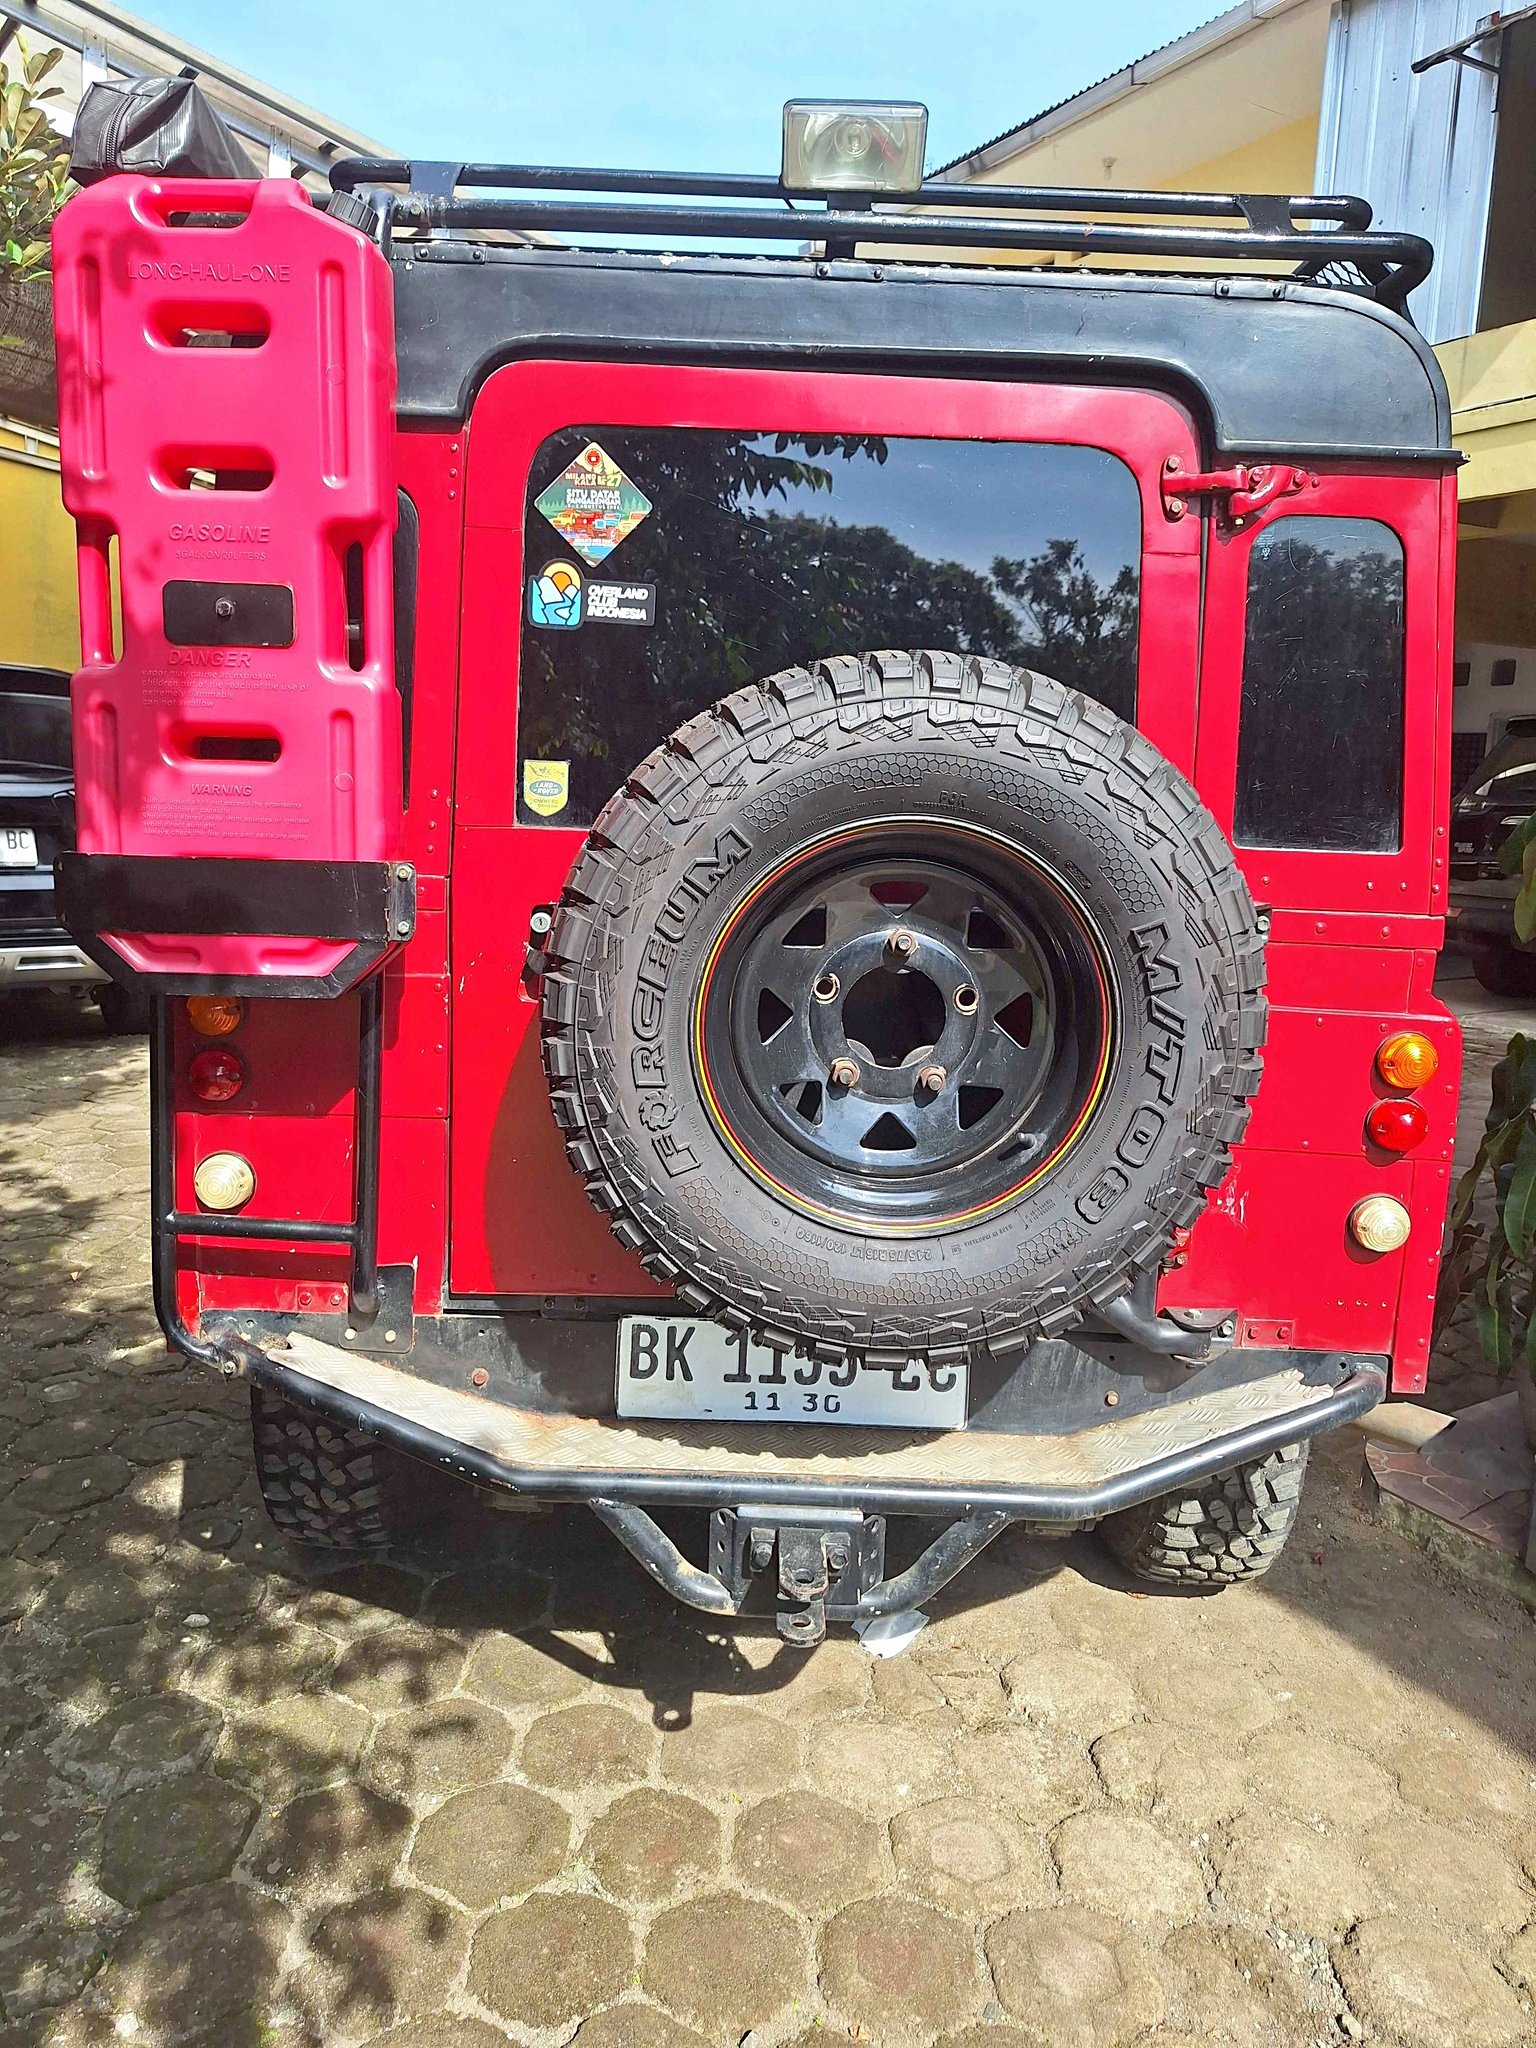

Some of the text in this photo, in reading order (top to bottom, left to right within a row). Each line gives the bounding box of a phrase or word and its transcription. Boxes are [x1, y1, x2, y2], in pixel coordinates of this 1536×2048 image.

[127, 261, 292, 283] LONG-HAUL-ONE
[566, 488, 620, 499] SITU DATAR
[169, 524, 271, 543] GASOLINE
[587, 585, 649, 600] OVERLAND
[587, 595, 619, 608] CLUB
[586, 605, 647, 620] INDONESIA
[167, 650, 252, 668] DANGER
[141, 669, 167, 678] vapor
[190, 671, 217, 679] cause
[233, 672, 277, 682] explosion
[141, 678, 178, 688] children
[225, 680, 251, 690] reach
[281, 684, 298, 692] use
[178, 700, 215, 709] swallow
[190, 783, 253, 797] WARNING
[6, 829, 30, 850] BC
[795, 1227, 847, 1255] 120/116Q
[866, 1248, 887, 1261] R16
[887, 1248, 932, 1262] 245/75
[629, 1324, 697, 1382] BK
[745, 1391, 780, 1412] 11
